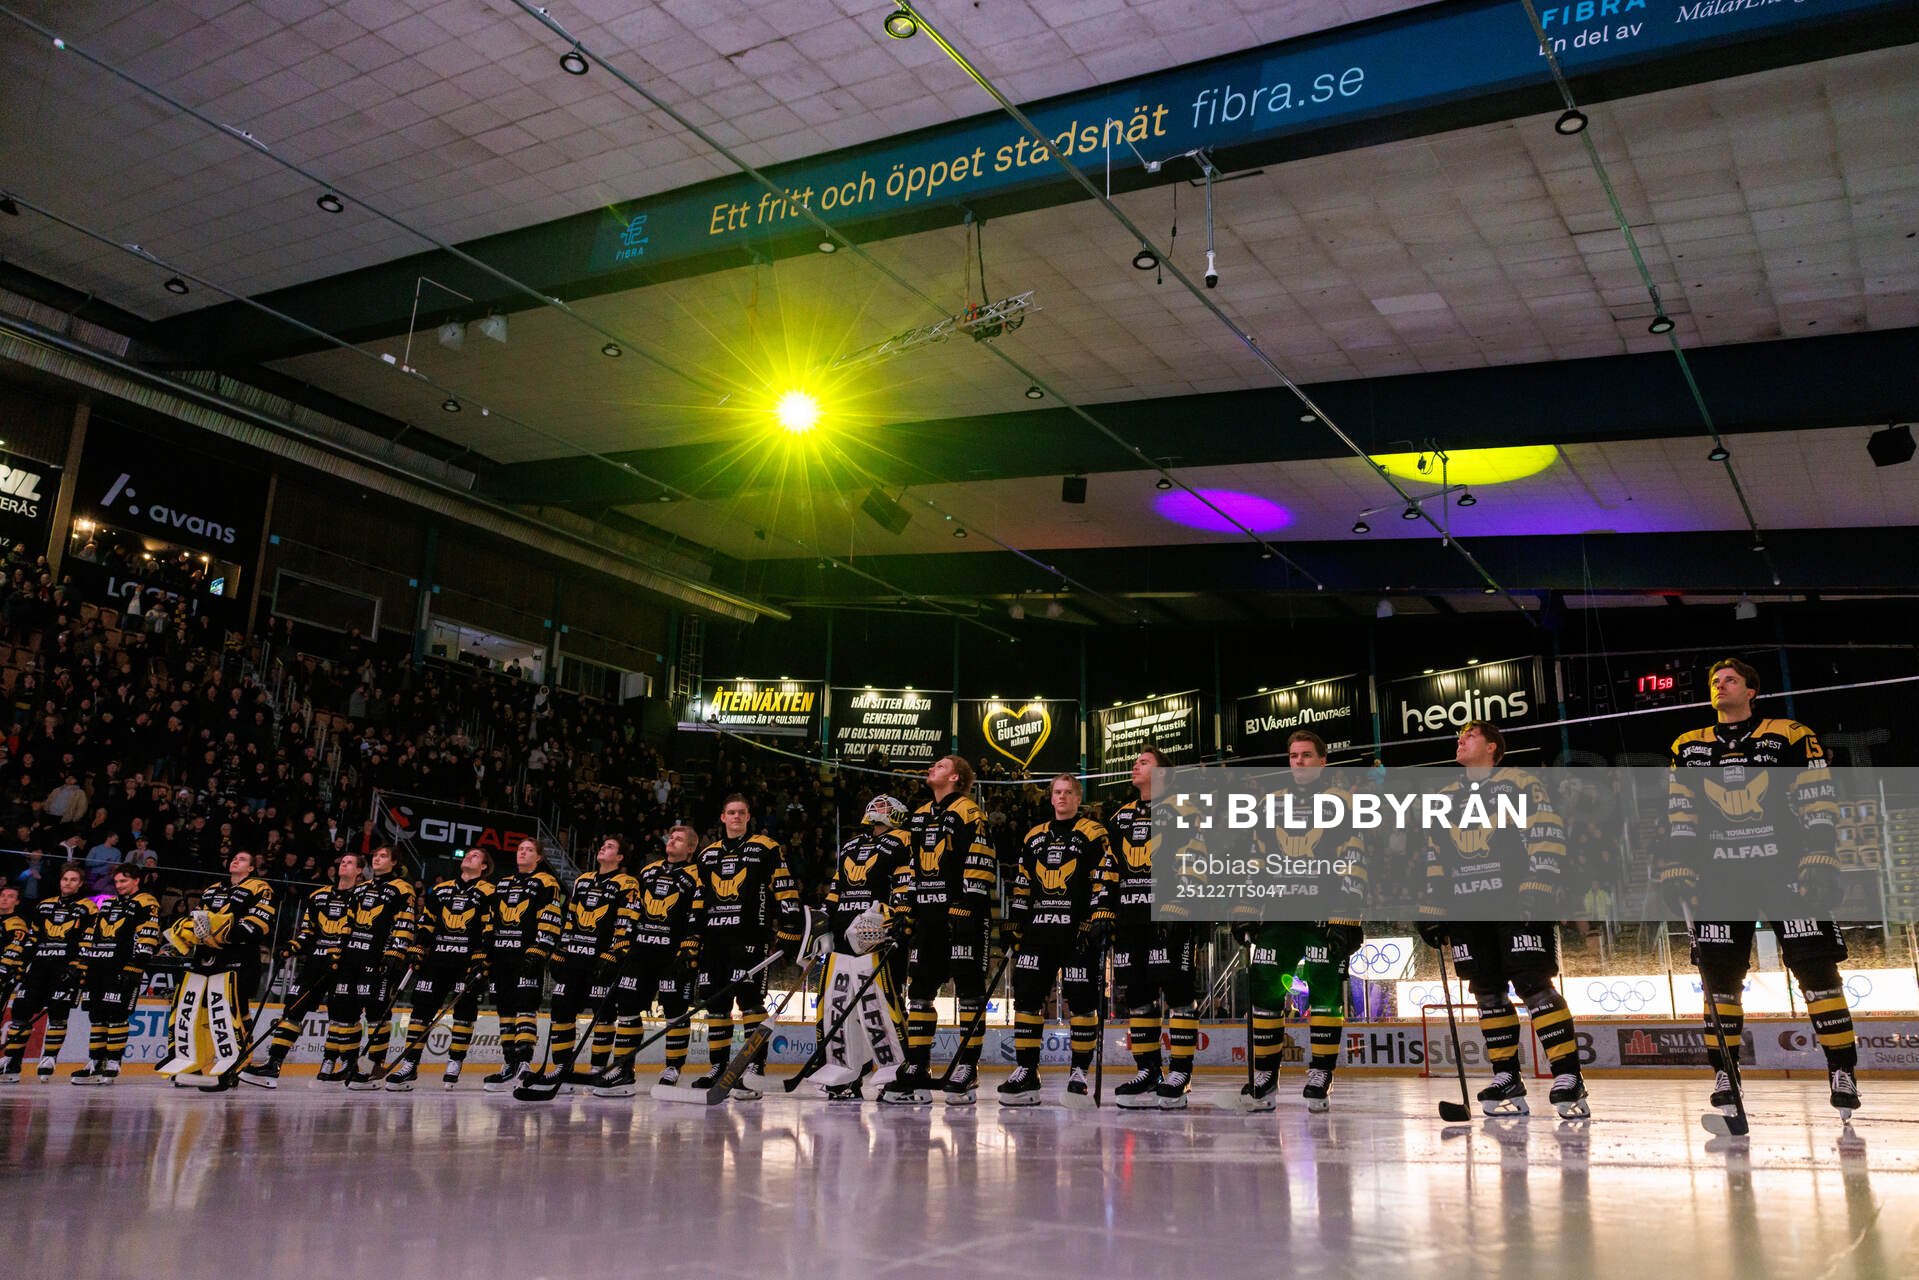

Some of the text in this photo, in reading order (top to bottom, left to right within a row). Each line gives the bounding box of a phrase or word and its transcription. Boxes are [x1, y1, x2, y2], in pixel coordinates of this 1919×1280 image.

[1541, 0, 1647, 30] FIBRA
[1573, 25, 1609, 48] del
[1615, 21, 1643, 40] av
[709, 66, 1365, 234] Ett fritt och öppet stadsnät fibra.se
[150, 503, 236, 544] avans
[711, 686, 815, 712] ÅTERVÄXTEN
[851, 695, 931, 711] HÄR SITTER NÄSTA
[863, 712, 919, 725] GENERATION
[1402, 689, 1529, 734] hedins
[776, 715, 810, 725] GULSVART
[996, 718, 1008, 729] ETT
[837, 727, 942, 741] AV GULSVARTA HJÄRTAN
[997, 720, 1042, 741] GULSVART
[1112, 720, 1187, 741] Isolering Akustik
[843, 743, 934, 757] TACK VRE ERT STÖD.
[1805, 735, 1824, 759] 15
[1797, 785, 1836, 801] JAN APE
[1530, 827, 1544, 838] AN
[1725, 825, 1774, 837] TOTALBYGGEN
[1713, 843, 1779, 860] ALFAB
[1460, 862, 1501, 873] TOTALBYGGEN
[1454, 877, 1503, 895] ALFAB
[1121, 893, 1156, 904] ALFAB
[838, 902, 870, 911] ALFAB
[708, 916, 740, 926] ALFAB
[1033, 914, 1070, 924] ALFAB
[348, 941, 371, 951] LFAB
[636, 934, 670, 945] ALFAB
[436, 945, 468, 953] ALFAB
[178, 991, 197, 1058] ALFAB
[210, 991, 233, 1058] ALFAB
[791, 1040, 817, 1055] Hyg
[1371, 1033, 1525, 1064] Hisste
